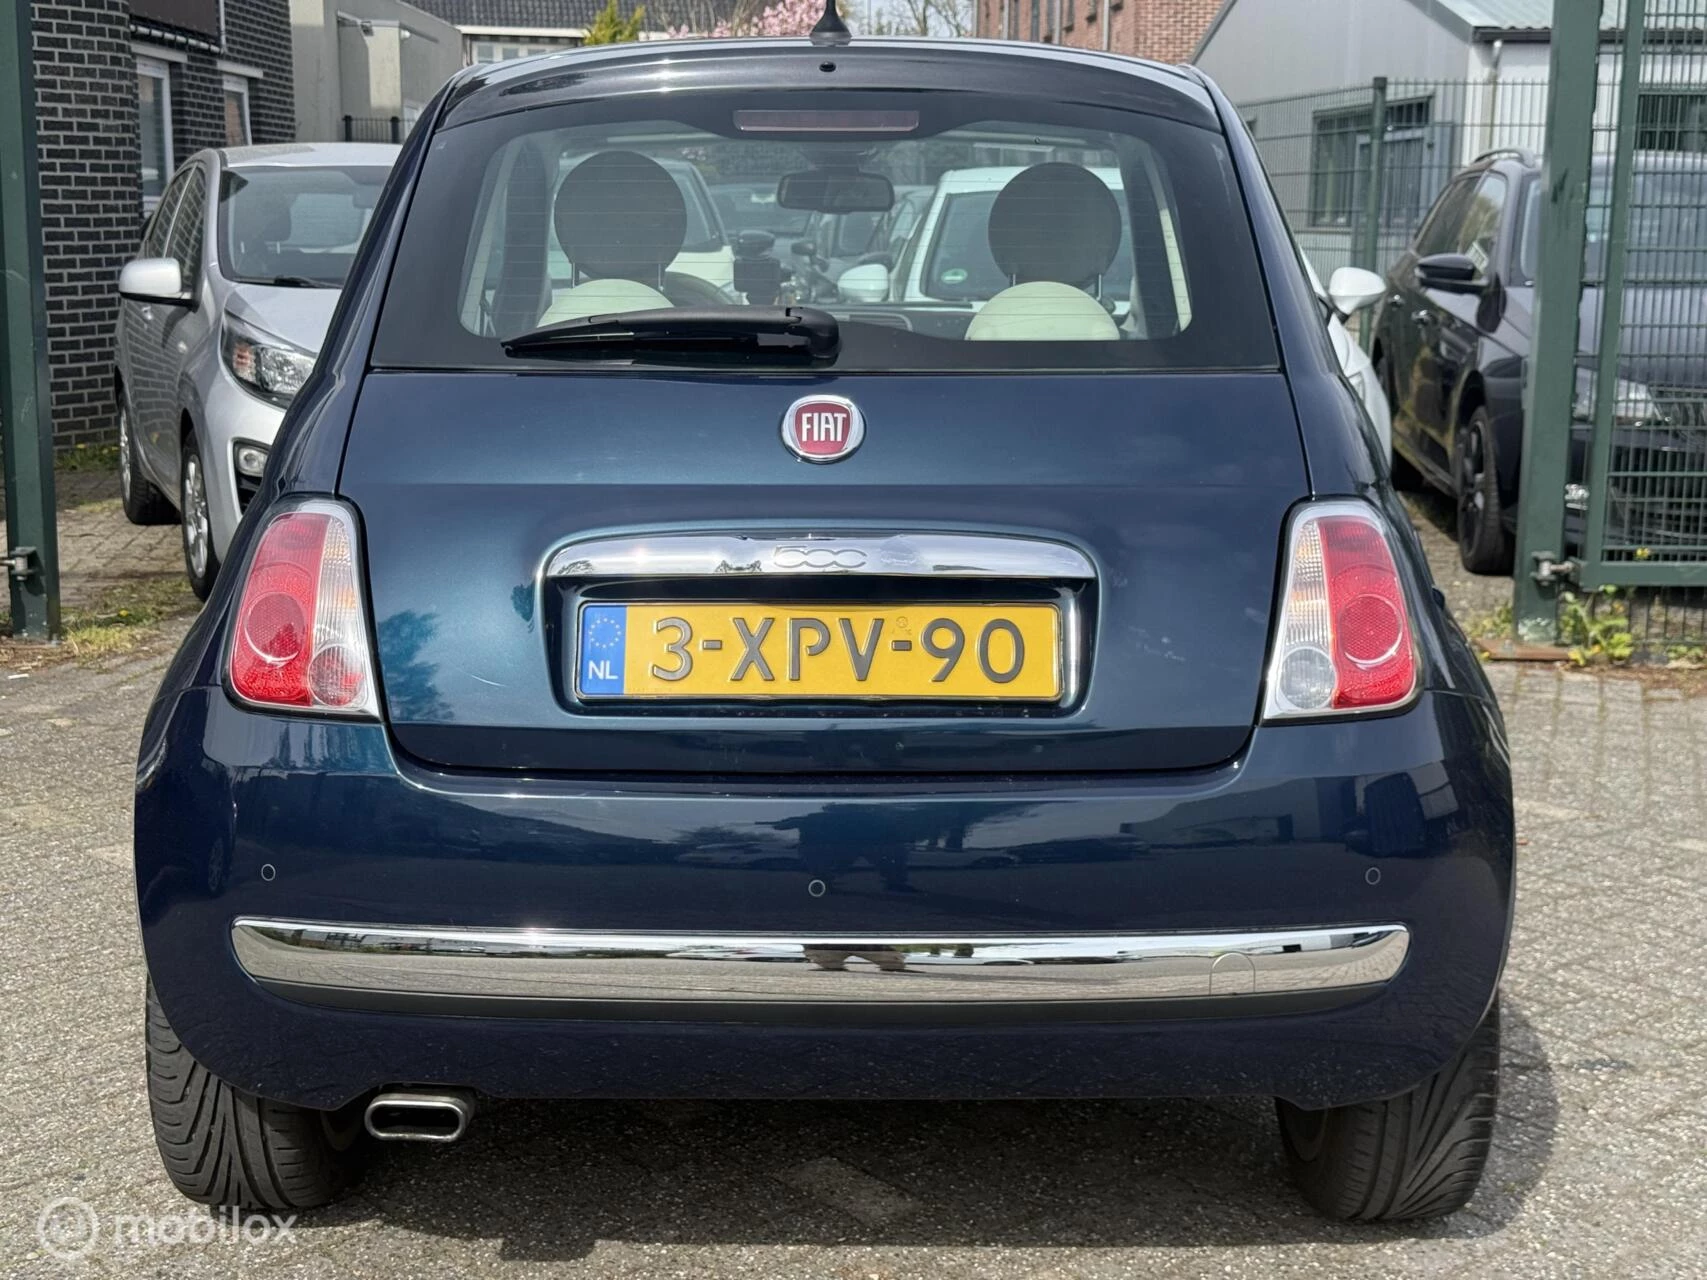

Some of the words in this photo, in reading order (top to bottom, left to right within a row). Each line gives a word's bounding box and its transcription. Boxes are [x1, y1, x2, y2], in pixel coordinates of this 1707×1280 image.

[802, 412, 847, 442] FIAT
[774, 545, 868, 569] 500
[651, 616, 1026, 684] 3-XPV-90
[588, 659, 619, 680] NL
